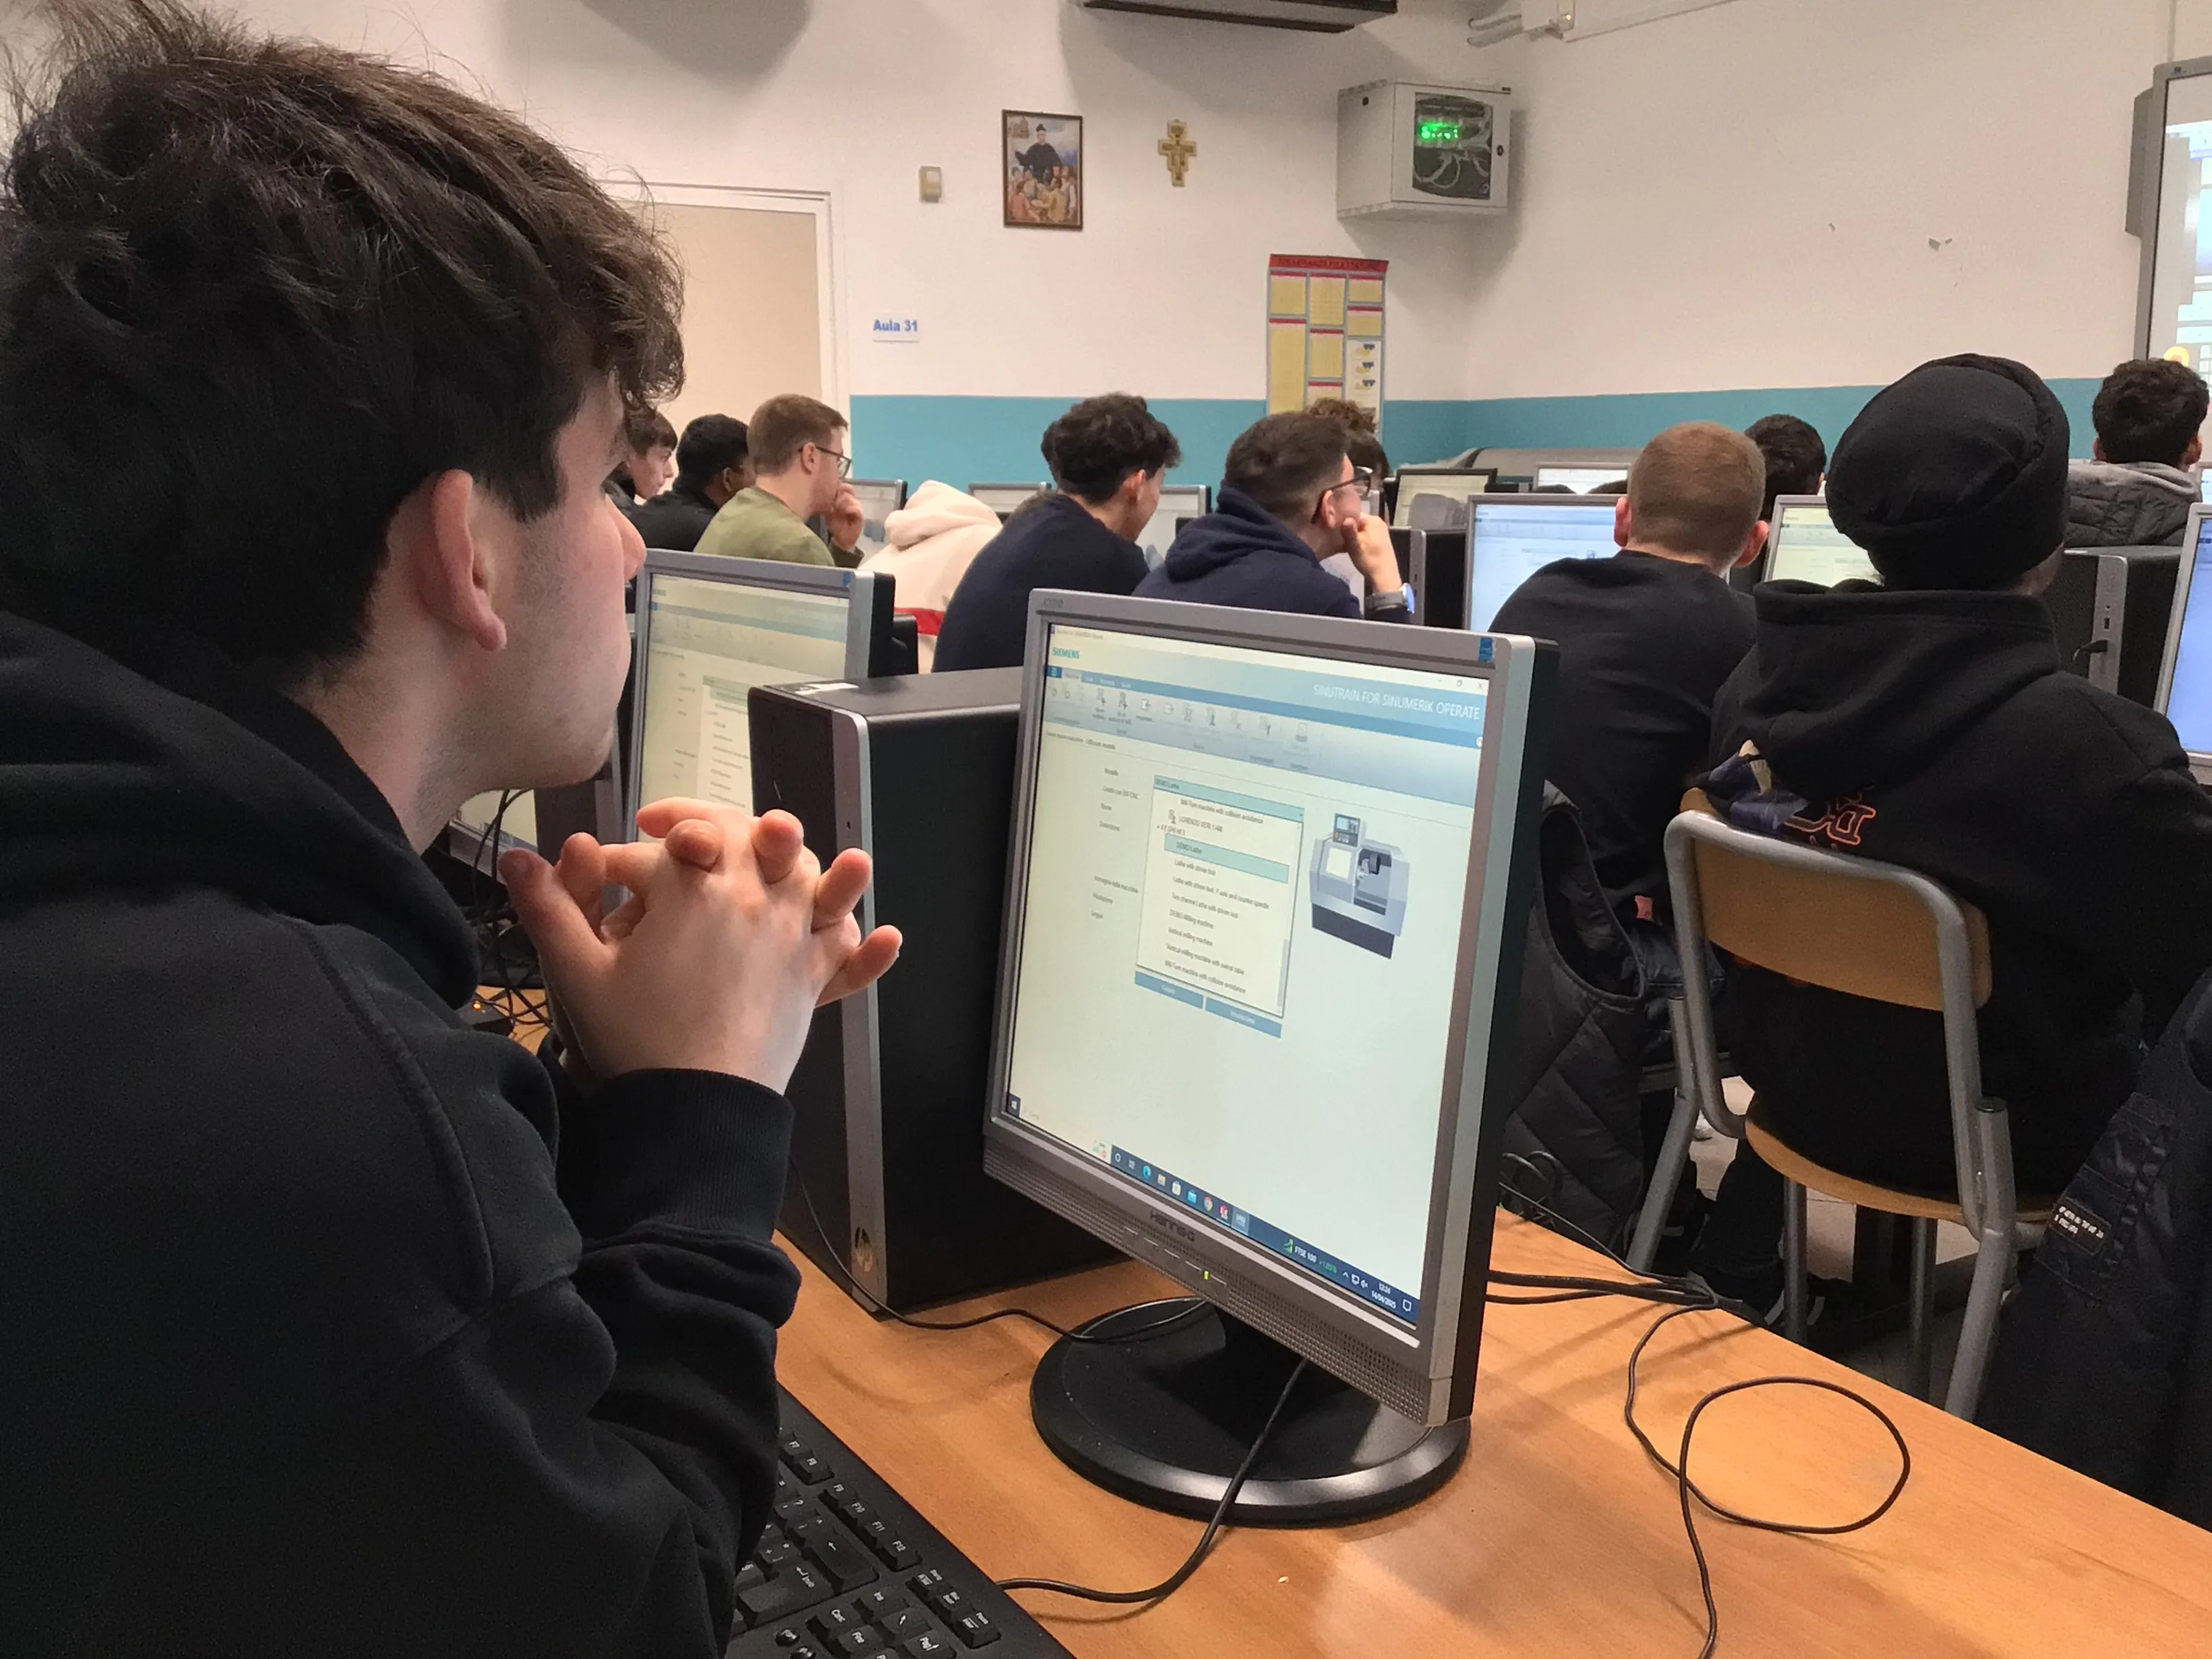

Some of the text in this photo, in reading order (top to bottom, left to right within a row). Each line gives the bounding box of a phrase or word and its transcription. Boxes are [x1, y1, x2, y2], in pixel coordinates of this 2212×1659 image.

[873, 319, 918, 331] Aula 31
[1052, 647, 1080, 659] SIEMENS
[1313, 683, 1480, 720] SINUTRAIN FOR SINUMERIK OPERATE
[1294, 1246, 1307, 1258] FTSE
[1307, 1252, 1317, 1263] 100
[789, 1440, 800, 1448] F7
[851, 1502, 865, 1513] F10
[872, 1521, 885, 1532] F11
[893, 1540, 907, 1552] F12
